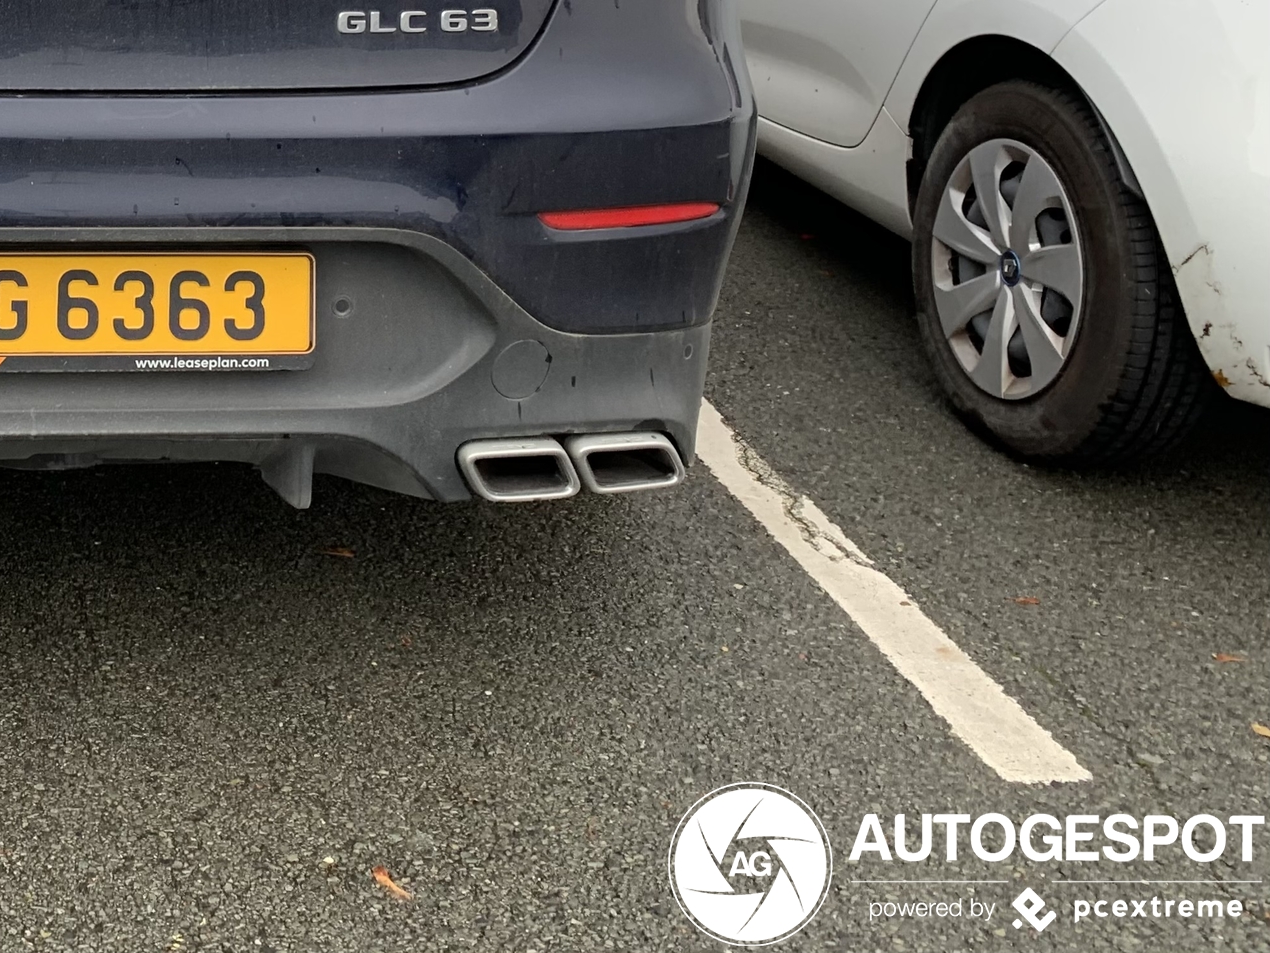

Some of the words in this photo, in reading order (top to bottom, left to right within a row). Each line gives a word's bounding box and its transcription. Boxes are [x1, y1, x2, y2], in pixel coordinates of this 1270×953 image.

[337, 11, 426, 33] GLC
[441, 9, 498, 32] 63
[57, 269, 265, 340] 6363
[135, 357, 270, 371] www.leaseplan.com
